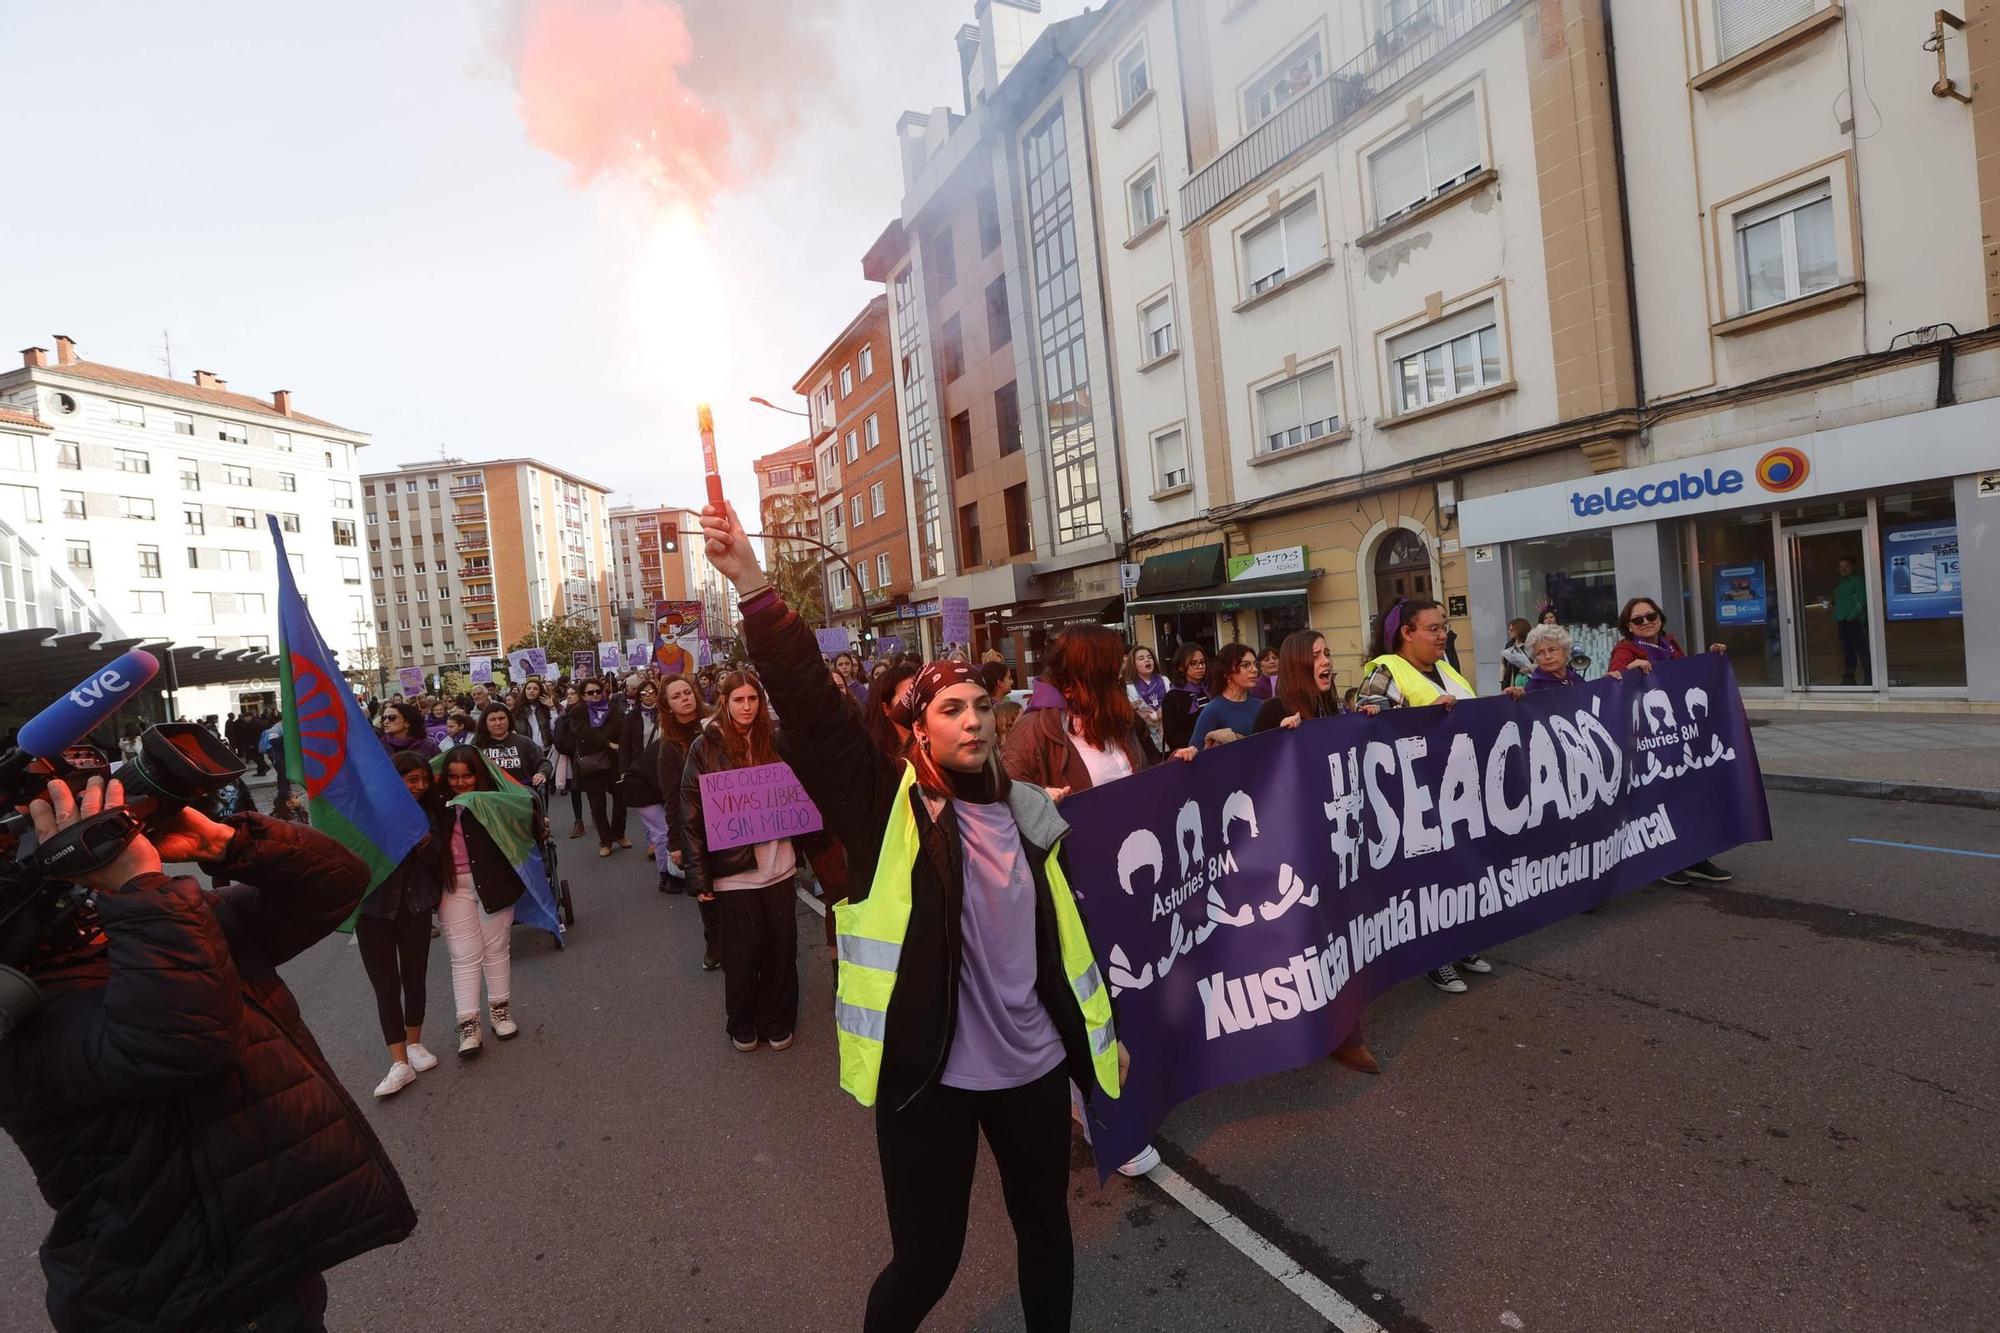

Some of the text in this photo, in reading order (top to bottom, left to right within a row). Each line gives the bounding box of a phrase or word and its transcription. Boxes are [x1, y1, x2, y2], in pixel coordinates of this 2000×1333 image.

[1570, 468, 1744, 517] telecable
[1234, 551, 1299, 569] TRASTOS
[69, 670, 130, 707] tve
[1636, 722, 1699, 752] Asturies 8M
[706, 773, 735, 793] NOS
[1324, 696, 1622, 890] #SEACABÓ
[712, 792, 761, 814] VIVAS
[712, 808, 810, 842] Y SIN MIEDO
[44, 845, 75, 865] Canon
[1152, 849, 1239, 922] Asturies 8M
[1197, 803, 1677, 1041] Xusticia Verdá Non al silenciu patriarcal
